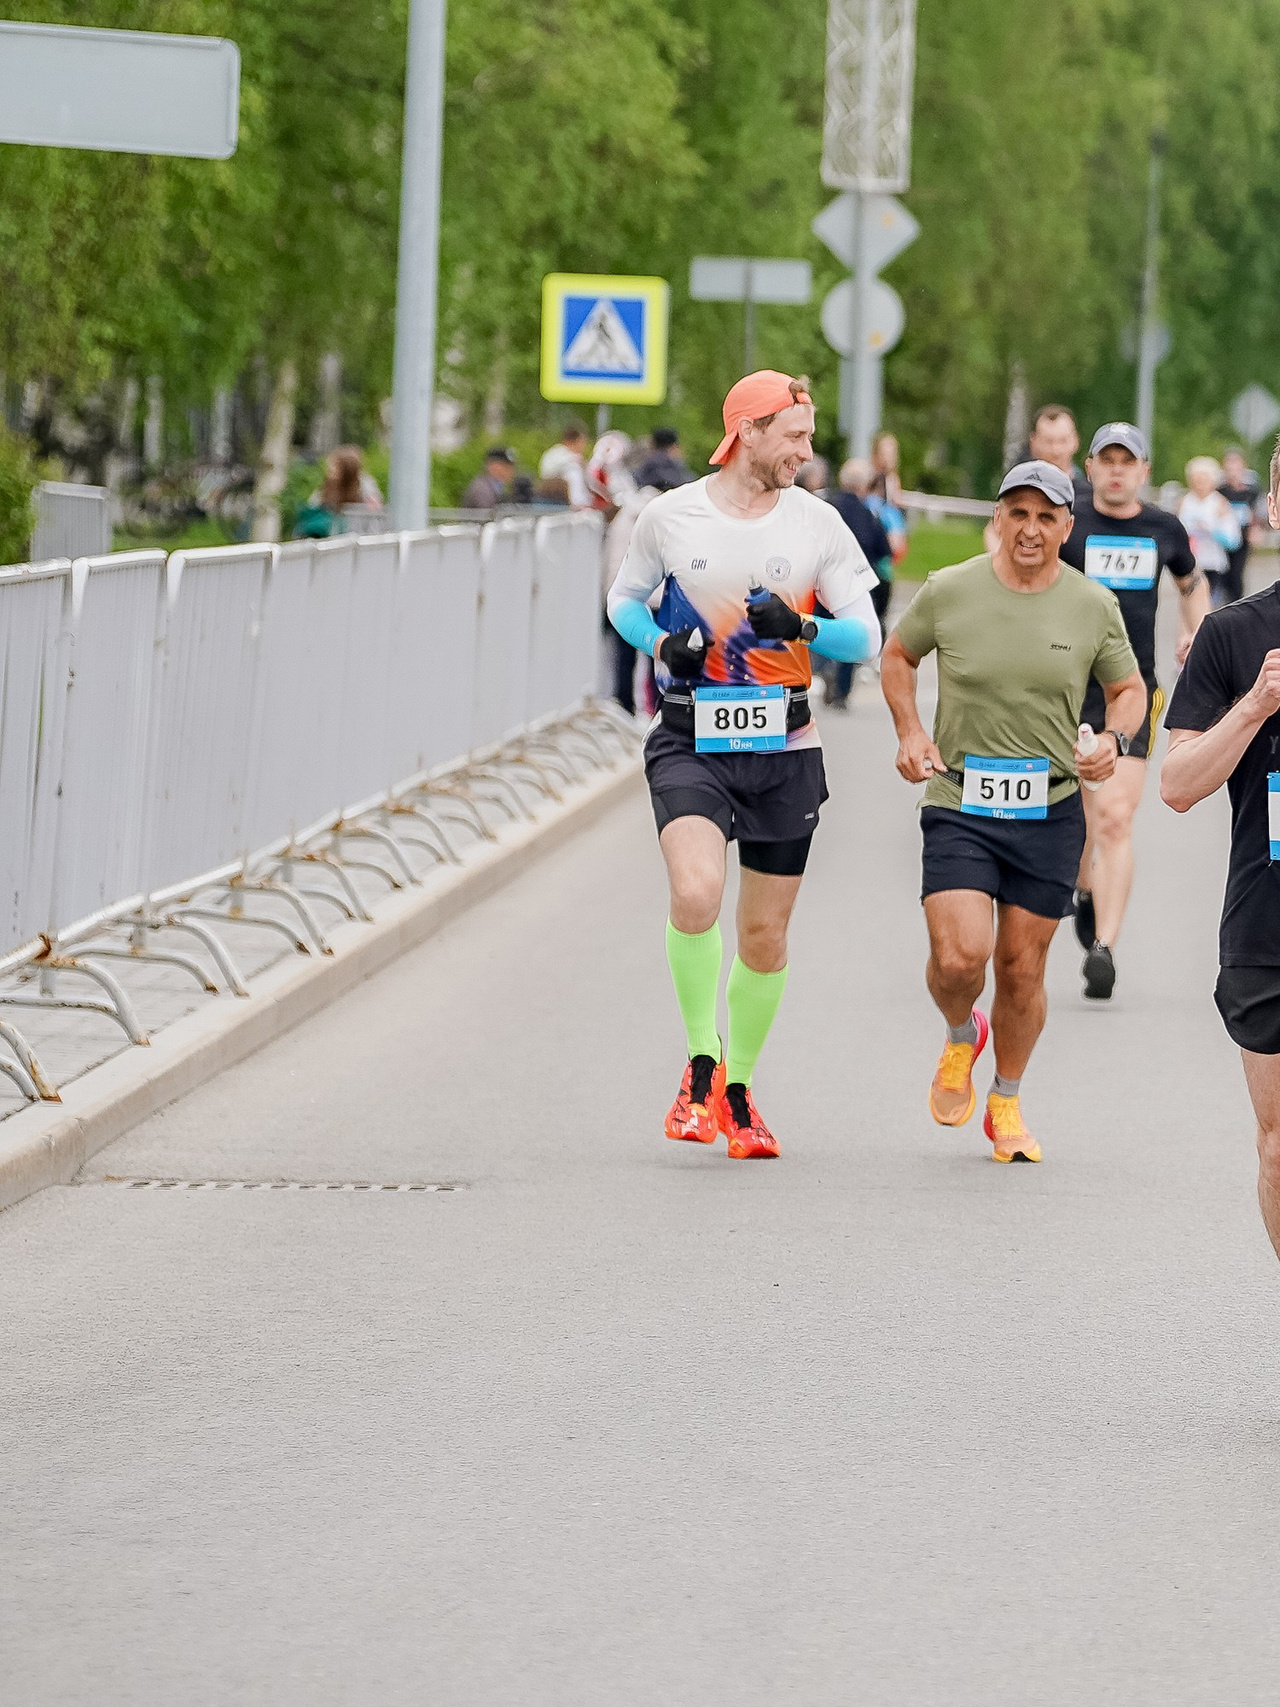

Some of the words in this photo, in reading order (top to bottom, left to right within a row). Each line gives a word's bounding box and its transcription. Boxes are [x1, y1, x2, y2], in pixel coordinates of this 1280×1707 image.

[1100, 553, 1139, 571] 767
[714, 706, 767, 730] 805
[979, 777, 1031, 802] 510
